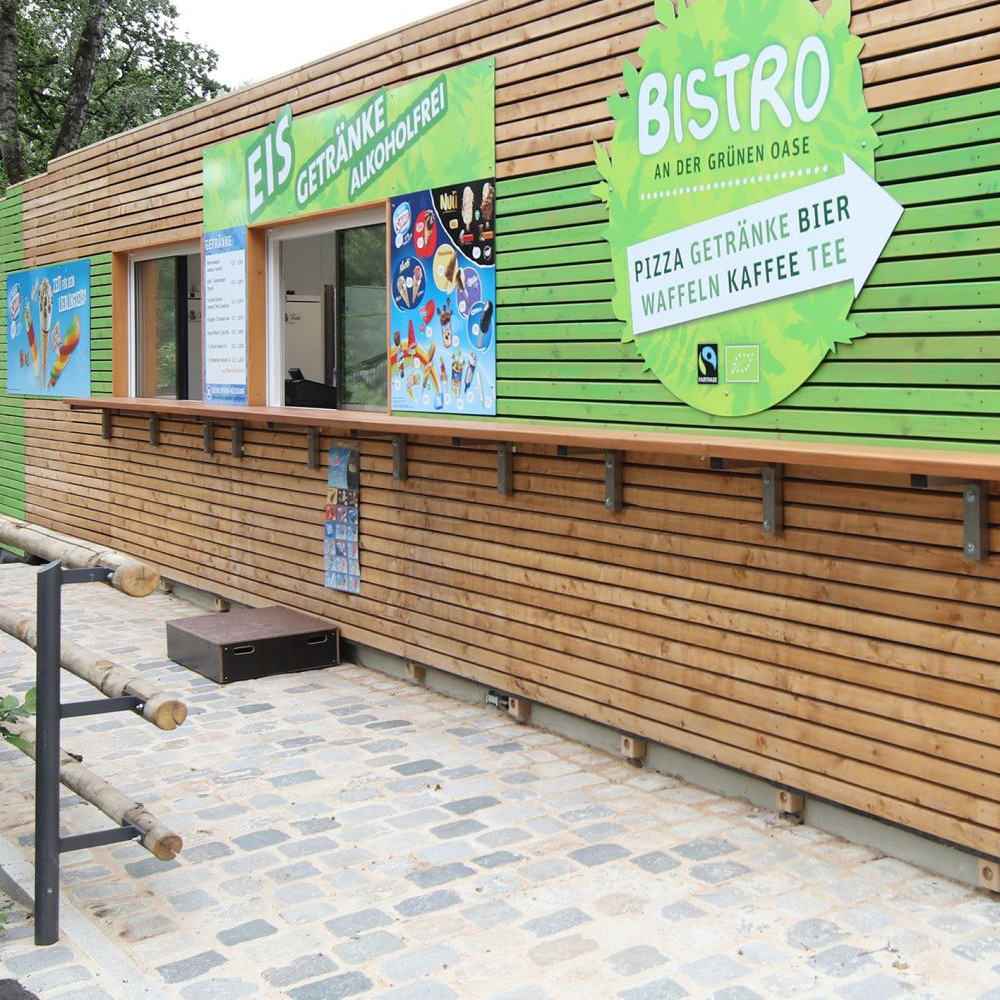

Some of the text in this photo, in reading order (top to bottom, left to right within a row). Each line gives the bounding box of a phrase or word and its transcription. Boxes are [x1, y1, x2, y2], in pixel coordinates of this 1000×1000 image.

[351, 82, 445, 196] ALKOHOLFREI
[638, 35, 830, 156] BISTRO
[248, 114, 292, 214] EIS
[297, 94, 385, 205] GETRÄNKE
[654, 136, 810, 180] AN DER GRÜNEN OASE
[205, 234, 232, 251] GETRÄNKE
[634, 195, 851, 283] PIZZA GETRÄNKE BIER
[640, 238, 847, 317] WAFFELN KAFFEE TEE
